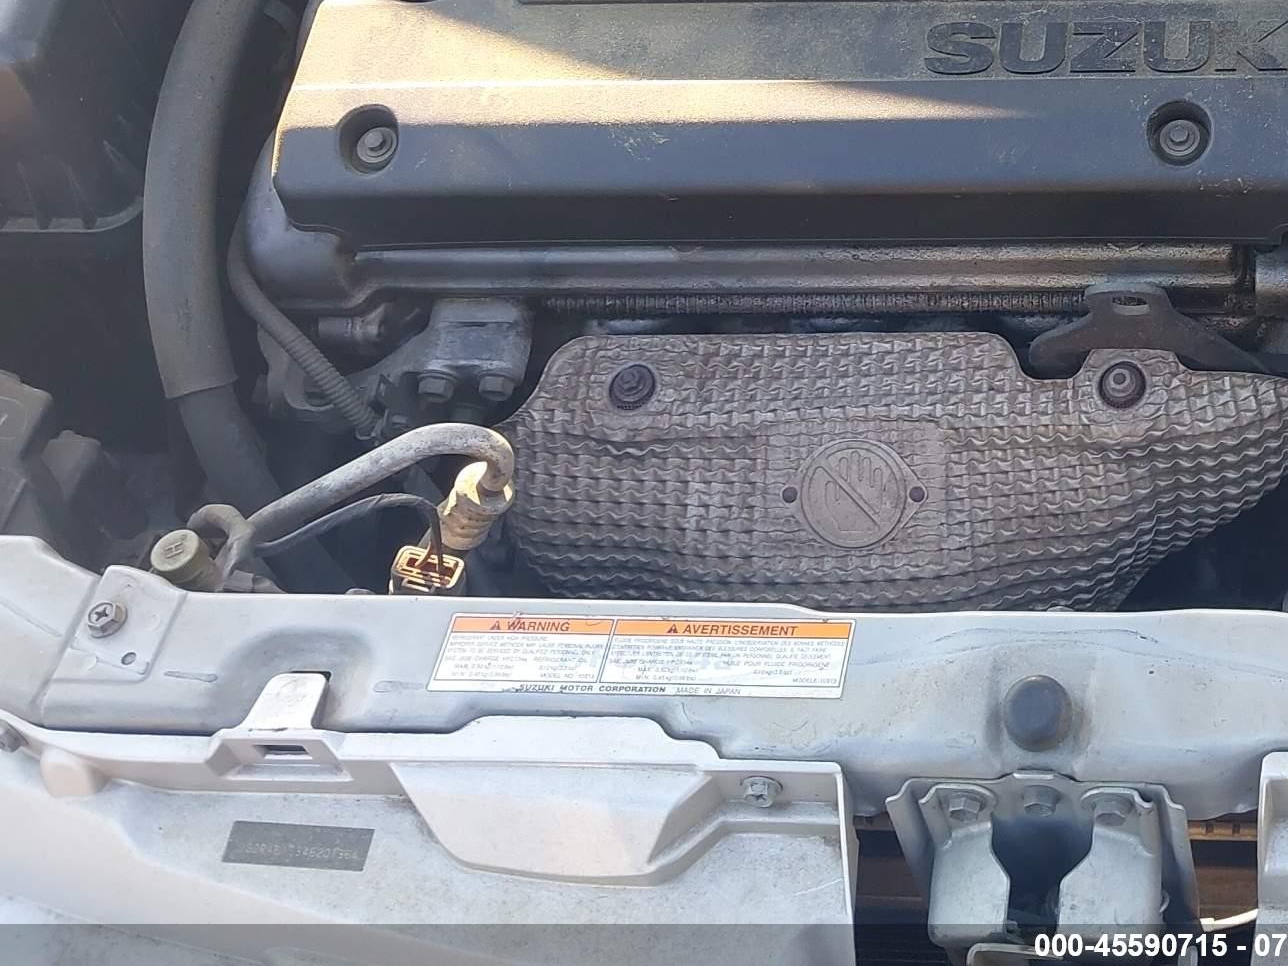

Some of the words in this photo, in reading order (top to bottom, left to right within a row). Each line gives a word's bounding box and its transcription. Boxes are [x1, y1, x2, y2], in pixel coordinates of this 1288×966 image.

[507, 620, 571, 632] WARNING
[683, 623, 799, 636] AVERTISSEMENT
[518, 683, 555, 692] SUZUKI
[559, 684, 594, 692] MOTOR
[598, 685, 667, 693] CORPORATION
